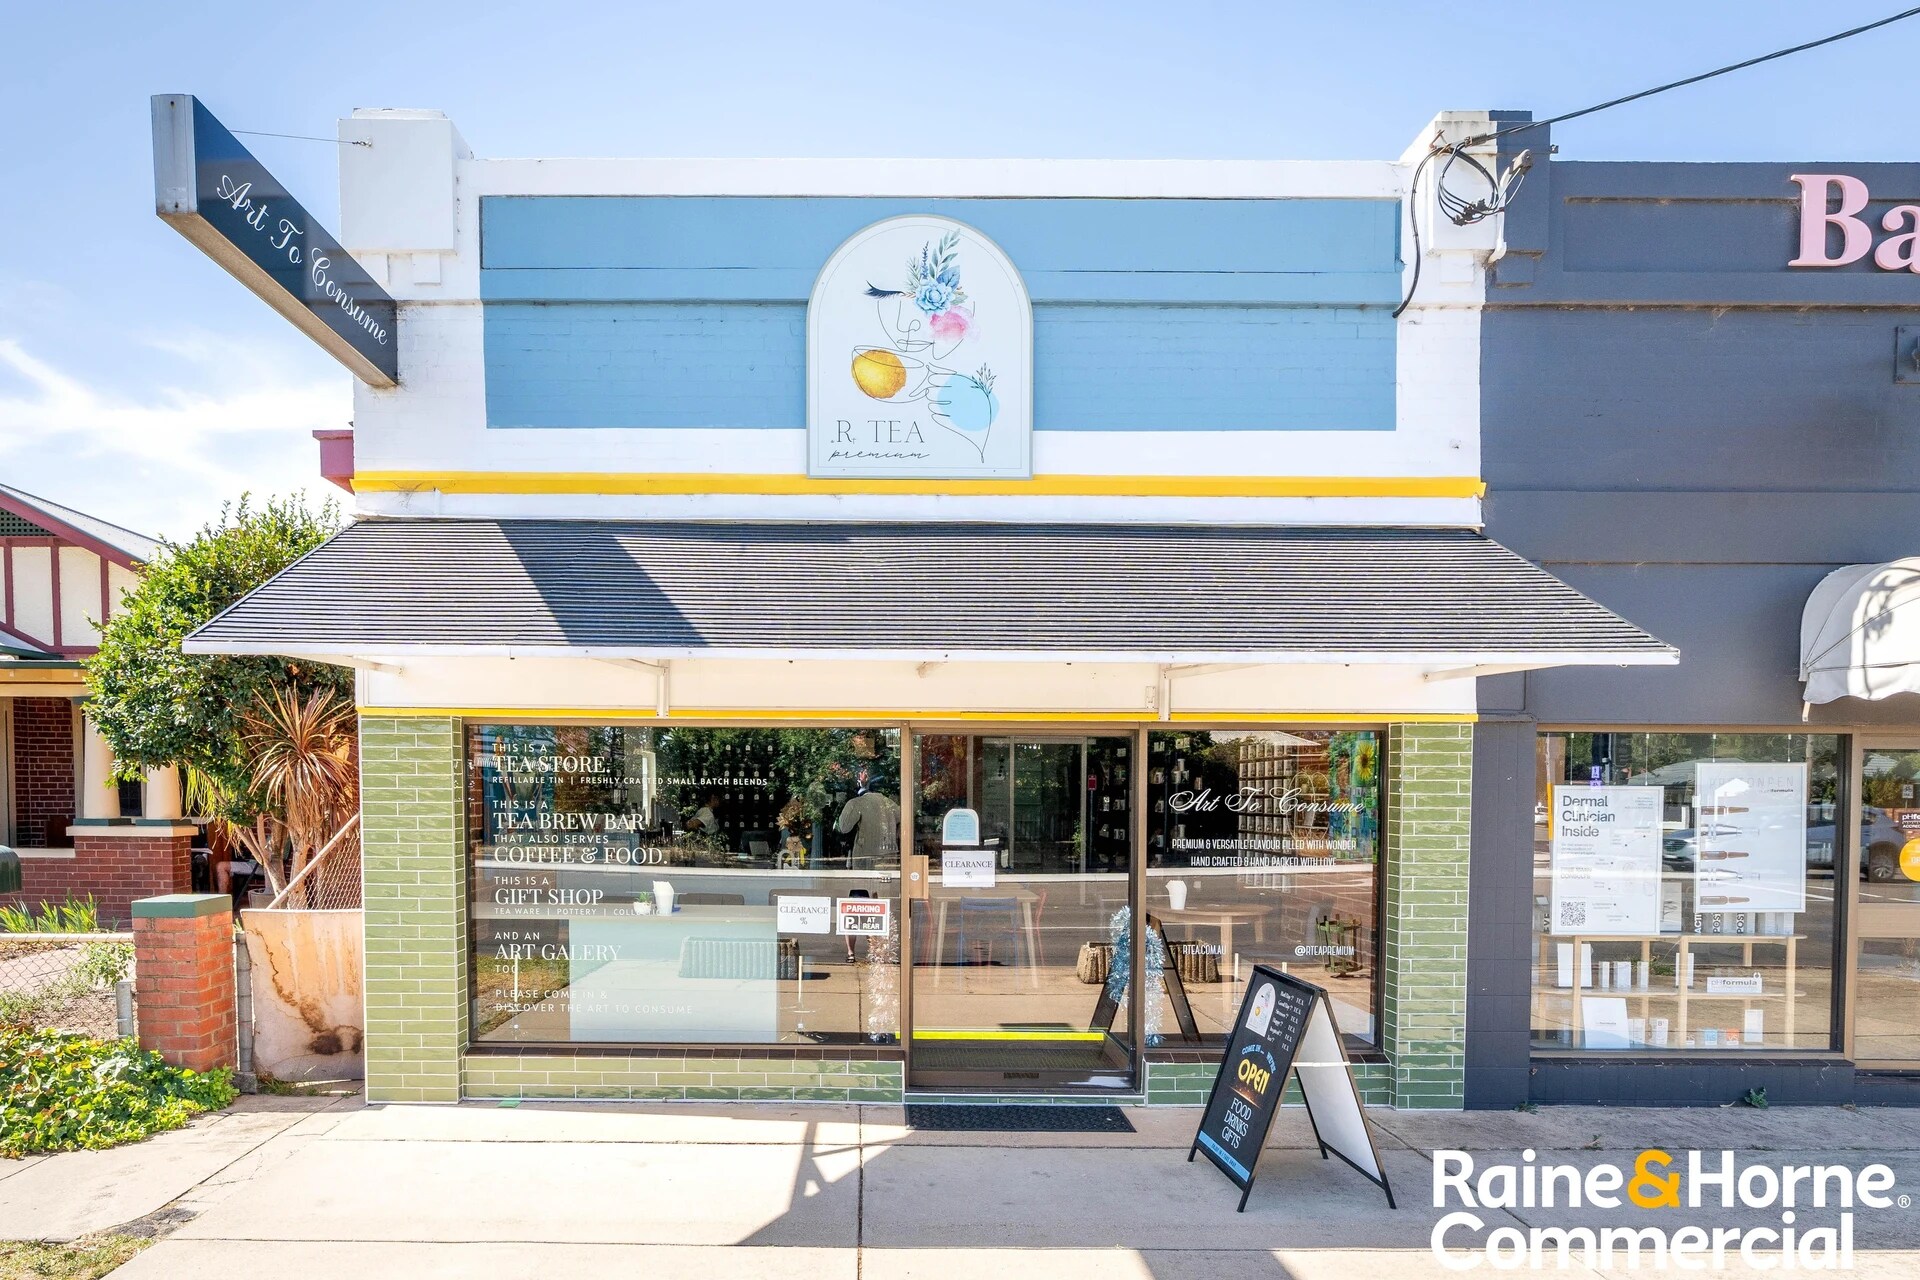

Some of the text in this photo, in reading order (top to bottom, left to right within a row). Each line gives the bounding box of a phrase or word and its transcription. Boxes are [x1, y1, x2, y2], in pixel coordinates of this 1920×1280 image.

[1787, 173, 1920, 274] Ba
[216, 174, 388, 345] Art To Consume
[867, 420, 925, 443] TEA
[828, 449, 930, 462] premium
[491, 743, 548, 752] THIS IS A
[493, 756, 611, 773] TEA STORE.
[667, 777, 697, 785] SMALL
[733, 778, 768, 786] BLENDS
[493, 800, 549, 809] THIS IS A
[1168, 786, 1365, 815] Art To Consume
[1563, 795, 1608, 806] Dermal
[1562, 810, 1615, 821] Clinician
[493, 812, 646, 831] TEA BREW BAR
[1562, 825, 1599, 837] Inside
[493, 834, 609, 844] THAT ALSO SERVES
[1171, 839, 1357, 850] PREMIUM & VERSATILE FLAVOUR FILLED WITH WONDER
[494, 847, 668, 865] COFFEE & FOOD.
[1190, 856, 1337, 867] HAND CRAFTED & HAND PACKED WITH LOVE
[494, 876, 549, 885] THIS IS A
[495, 888, 604, 905] GIFT SHOP
[557, 908, 597, 916] POTTERY
[779, 906, 829, 914] CLEARANCE
[846, 905, 880, 913] PARKING
[800, 917, 808, 925] %
[494, 932, 540, 940] AND AN
[494, 943, 622, 961] ART GALERY
[1294, 945, 1355, 957] @RTEAPREMIUM
[495, 989, 608, 999] PLEASE COME IN &
[495, 1003, 693, 1014] DISCOVER THE ART TO CONSUME
[1238, 1058, 1270, 1095] OPEN
[1231, 1098, 1252, 1120] FOOD
[1224, 1110, 1249, 1137] DRINKS
[1222, 1126, 1240, 1149] GIFTS
